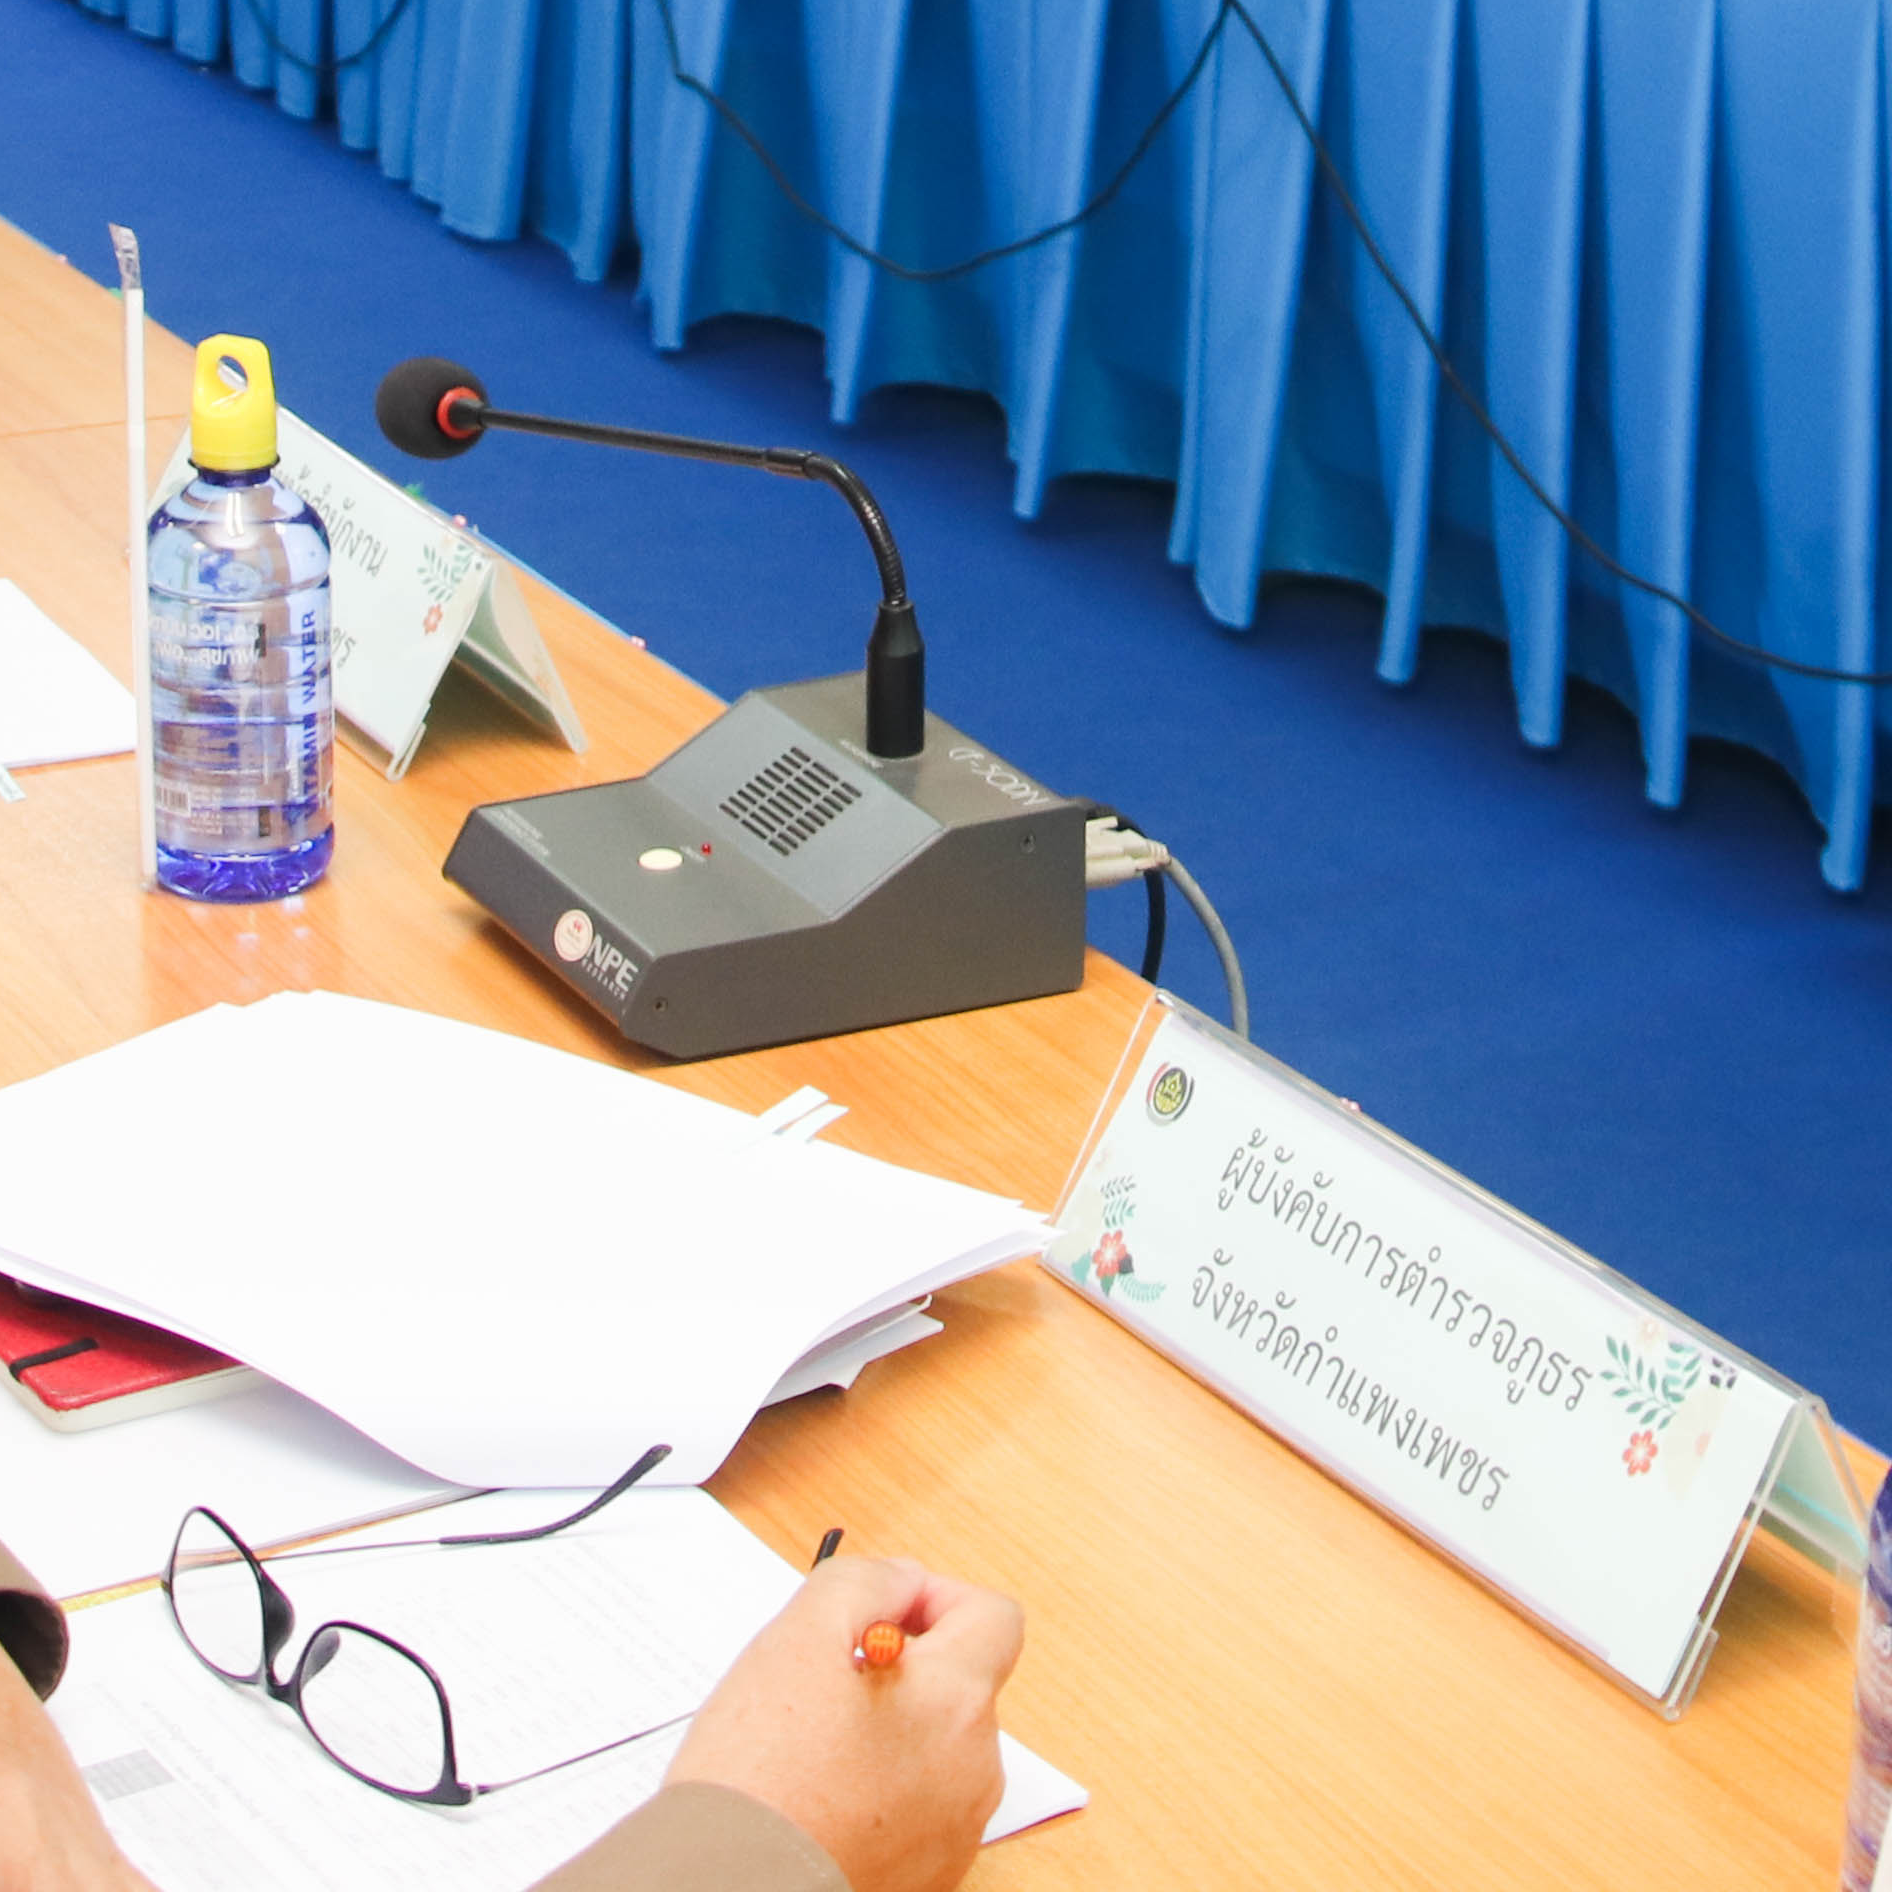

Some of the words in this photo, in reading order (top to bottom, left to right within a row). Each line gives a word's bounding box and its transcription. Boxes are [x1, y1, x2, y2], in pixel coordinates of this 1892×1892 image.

[301, 609, 317, 705] WATER
[586, 933, 639, 992] NPE
[1219, 1127, 1593, 1413] ผู้บังคับการตำรวจภูธร
[1191, 1248, 1512, 1512] จังหวัดกำแพงเพชร
